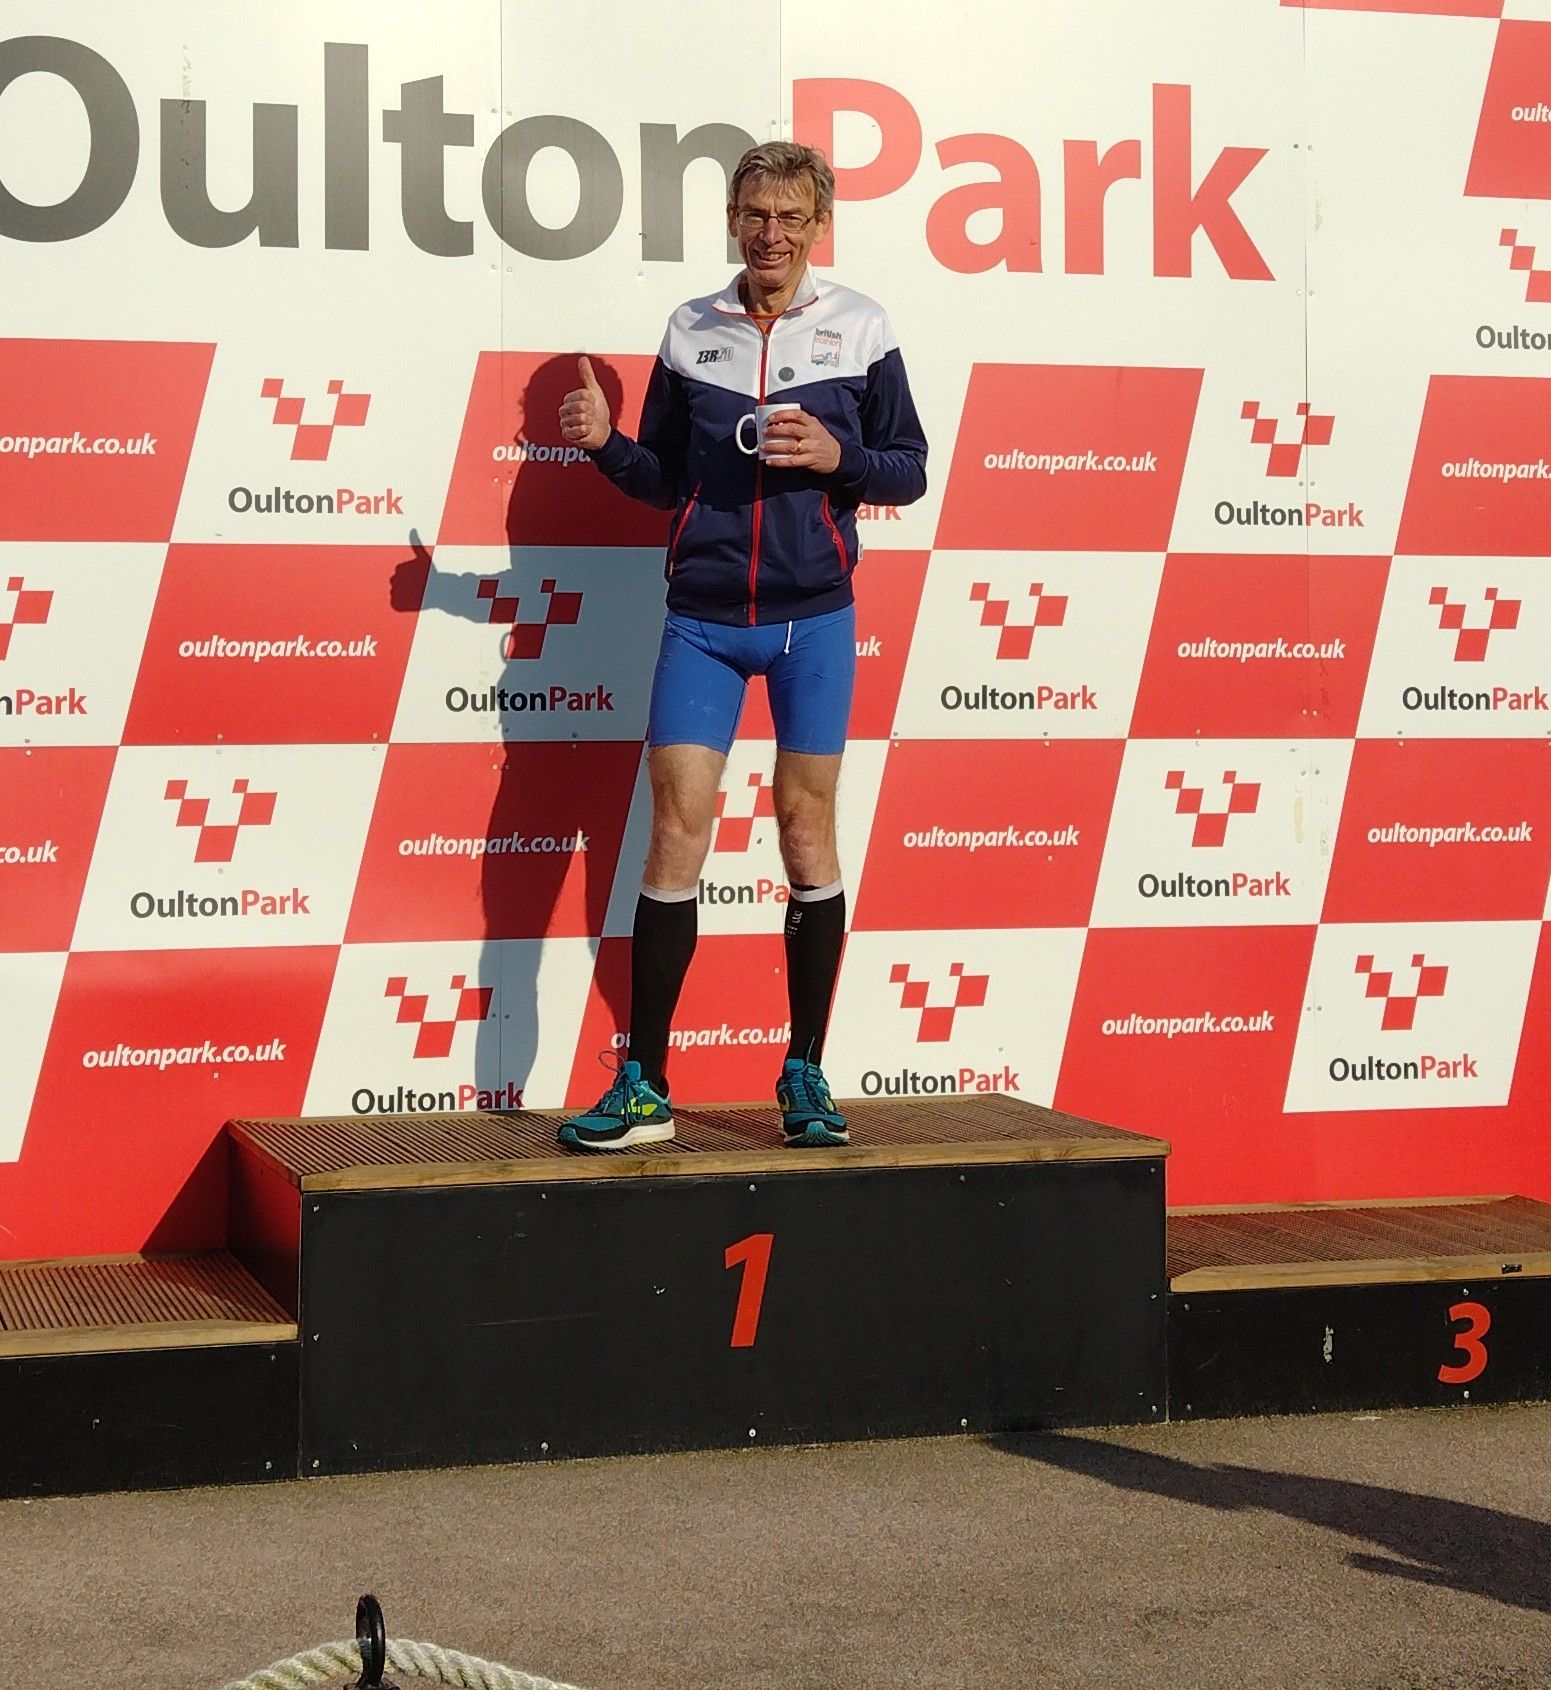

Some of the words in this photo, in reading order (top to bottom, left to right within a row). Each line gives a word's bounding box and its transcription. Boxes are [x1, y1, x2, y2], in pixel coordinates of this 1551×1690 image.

[1475, 325, 1551, 350] Oulto
[984, 449, 1157, 475] oultonpark.co.uk
[228, 487, 403, 514] OultonPark
[1214, 501, 1364, 527] OultonPark
[179, 635, 378, 662] oultonpark.co.uk
[1178, 637, 1347, 664] oultonpark.co.uk
[446, 685, 614, 713] OultonPark
[941, 685, 1097, 711] OultonPark
[1402, 685, 1549, 711] OultonPark
[398, 830, 590, 857] oultonpark.co.uk
[904, 825, 1080, 852] oultonpark.co.uk
[1368, 821, 1533, 848] oultonpark.co.uk
[699, 878, 789, 905] ltonPa
[1138, 872, 1291, 898] OultonPark
[131, 888, 310, 919] OultonPark
[1102, 1011, 1274, 1038] oultonpark.co.uk
[83, 1039, 286, 1069] oultonpark.co.uk
[1329, 1053, 1478, 1082] OultonPark
[860, 1065, 1020, 1096] OultonPark
[351, 1082, 525, 1115] OultonPark
[725, 1234, 774, 1347] 1
[1438, 1302, 1491, 1383] 3
